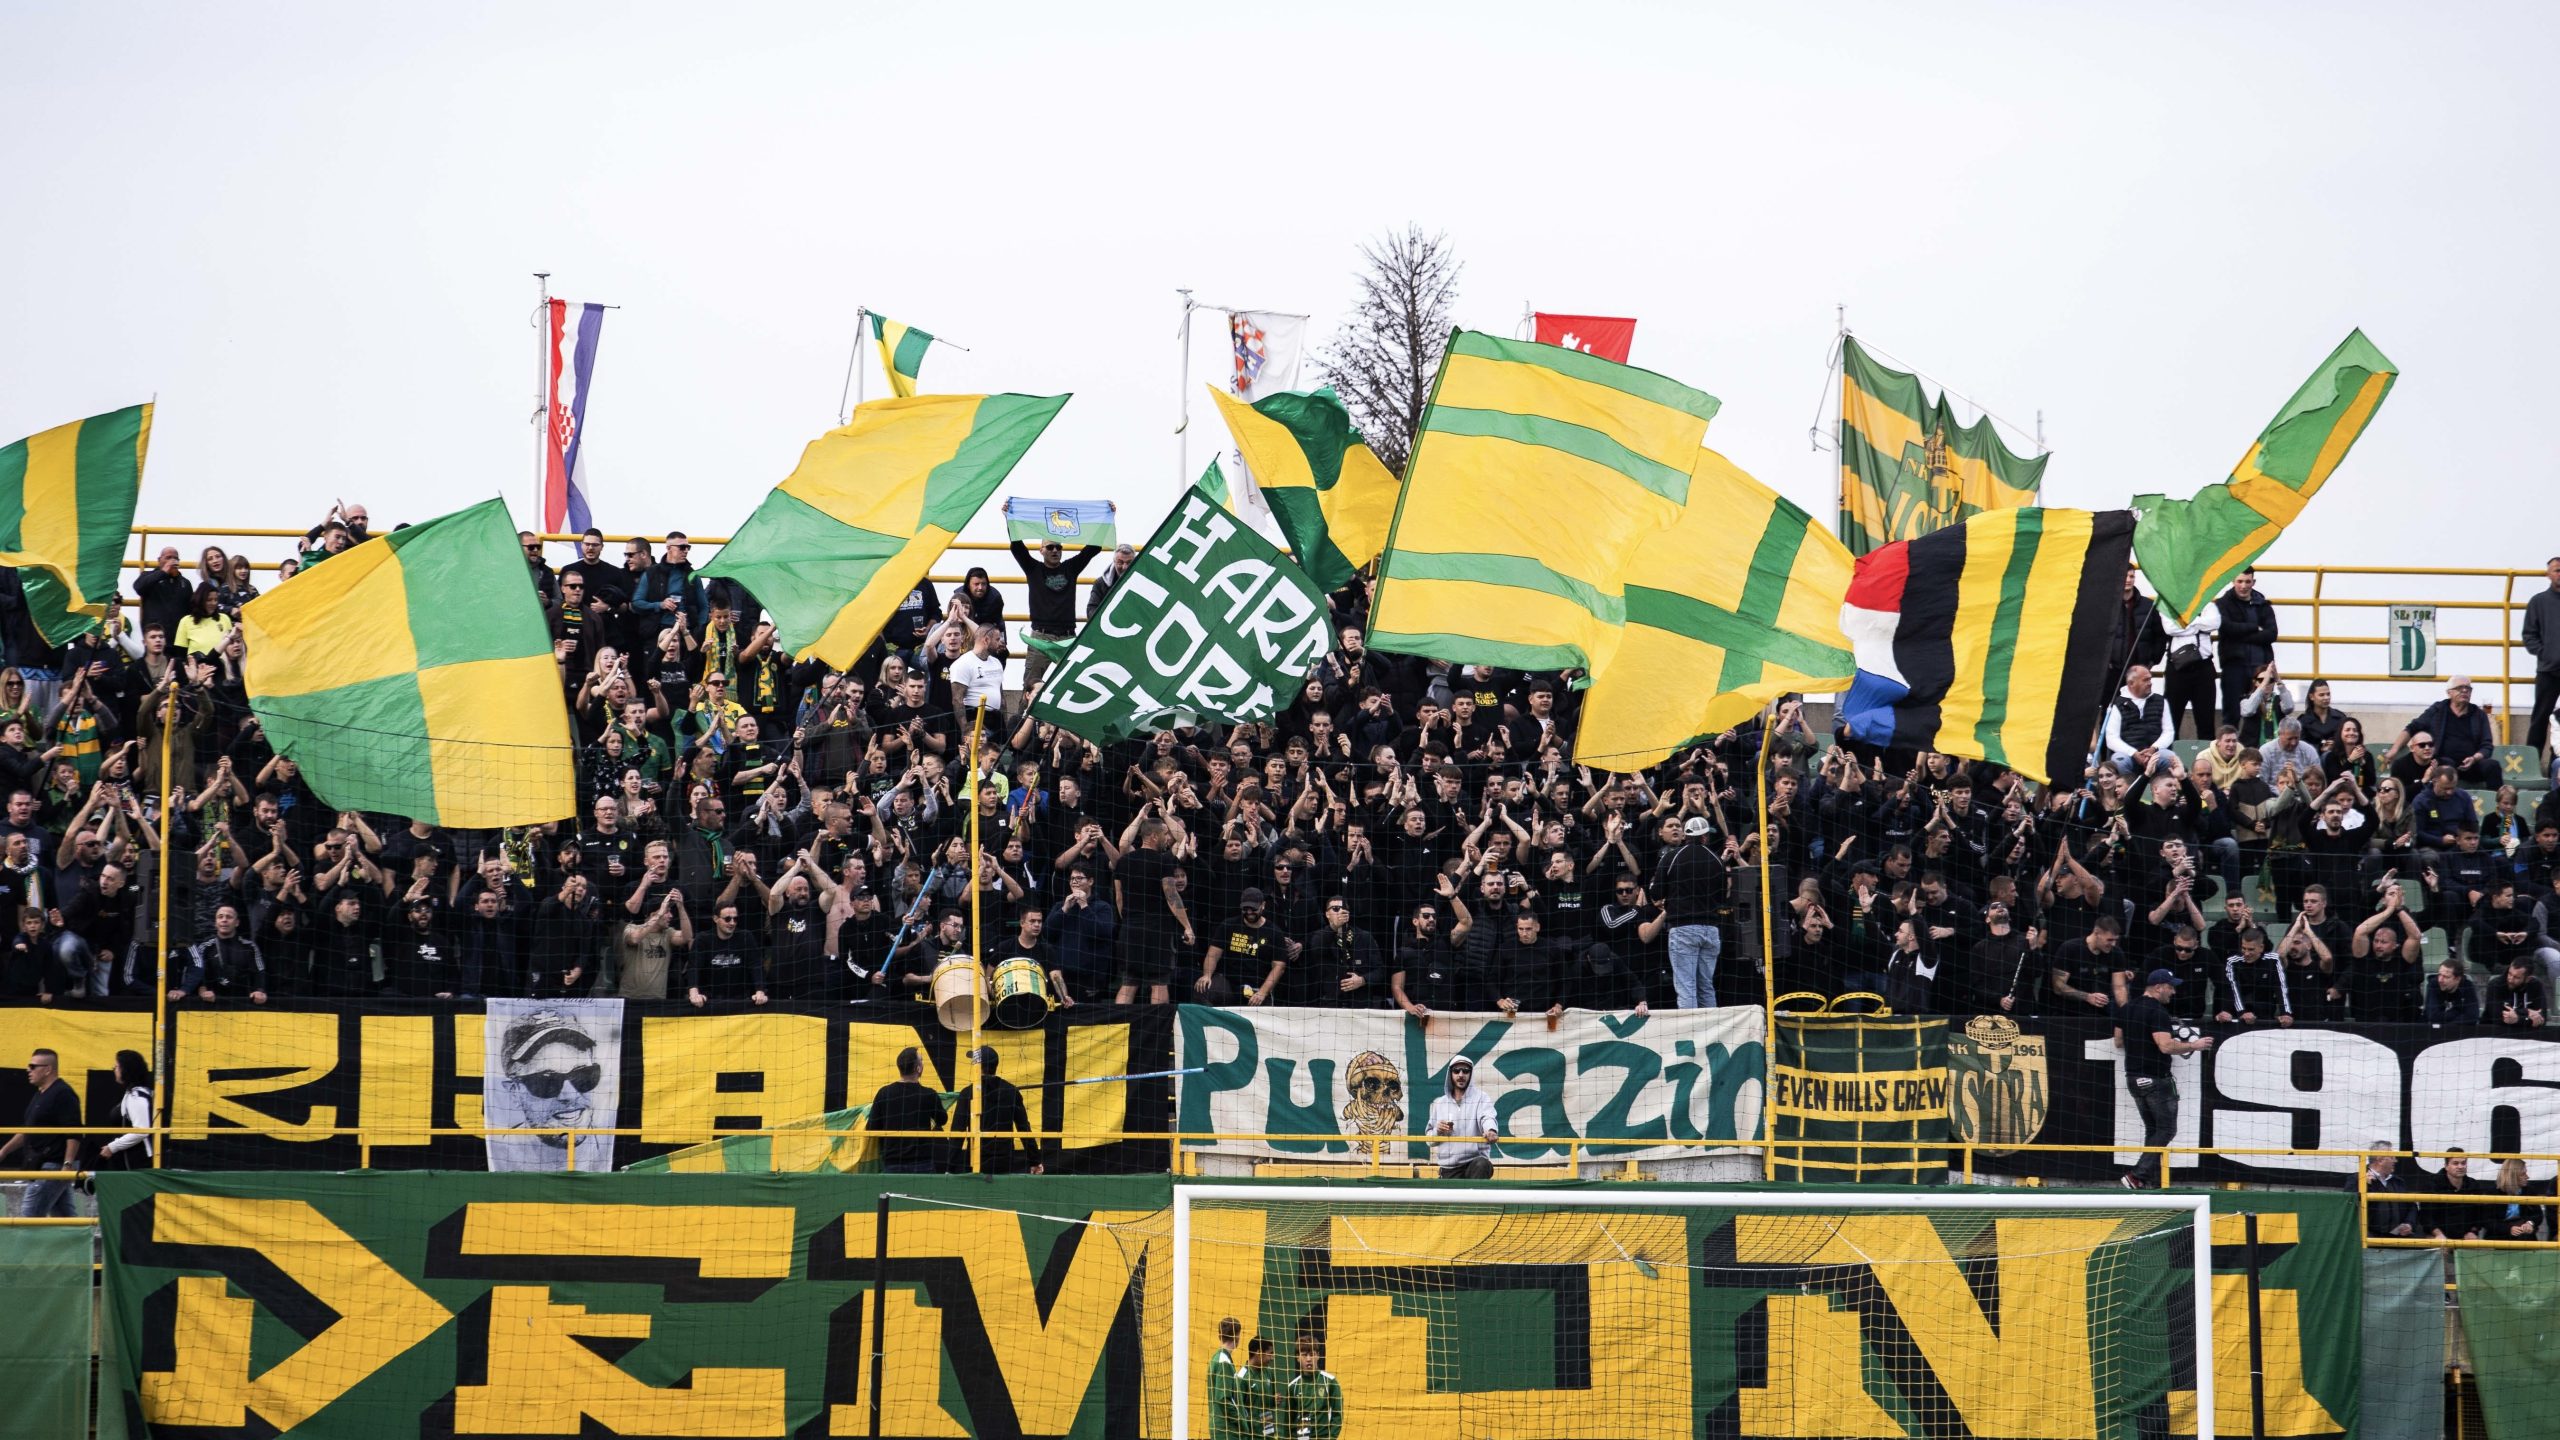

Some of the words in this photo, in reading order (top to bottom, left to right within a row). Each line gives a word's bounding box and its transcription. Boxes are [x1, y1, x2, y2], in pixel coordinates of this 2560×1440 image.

[2398, 626, 2427, 671] D
[2013, 1044, 2045, 1057] 1961
[1776, 1073, 1829, 1112] EVEN
[1833, 1079, 1889, 1112] HILLS
[1893, 1077, 1948, 1112] CREW
[130, 1192, 2348, 1440] DEMONI
